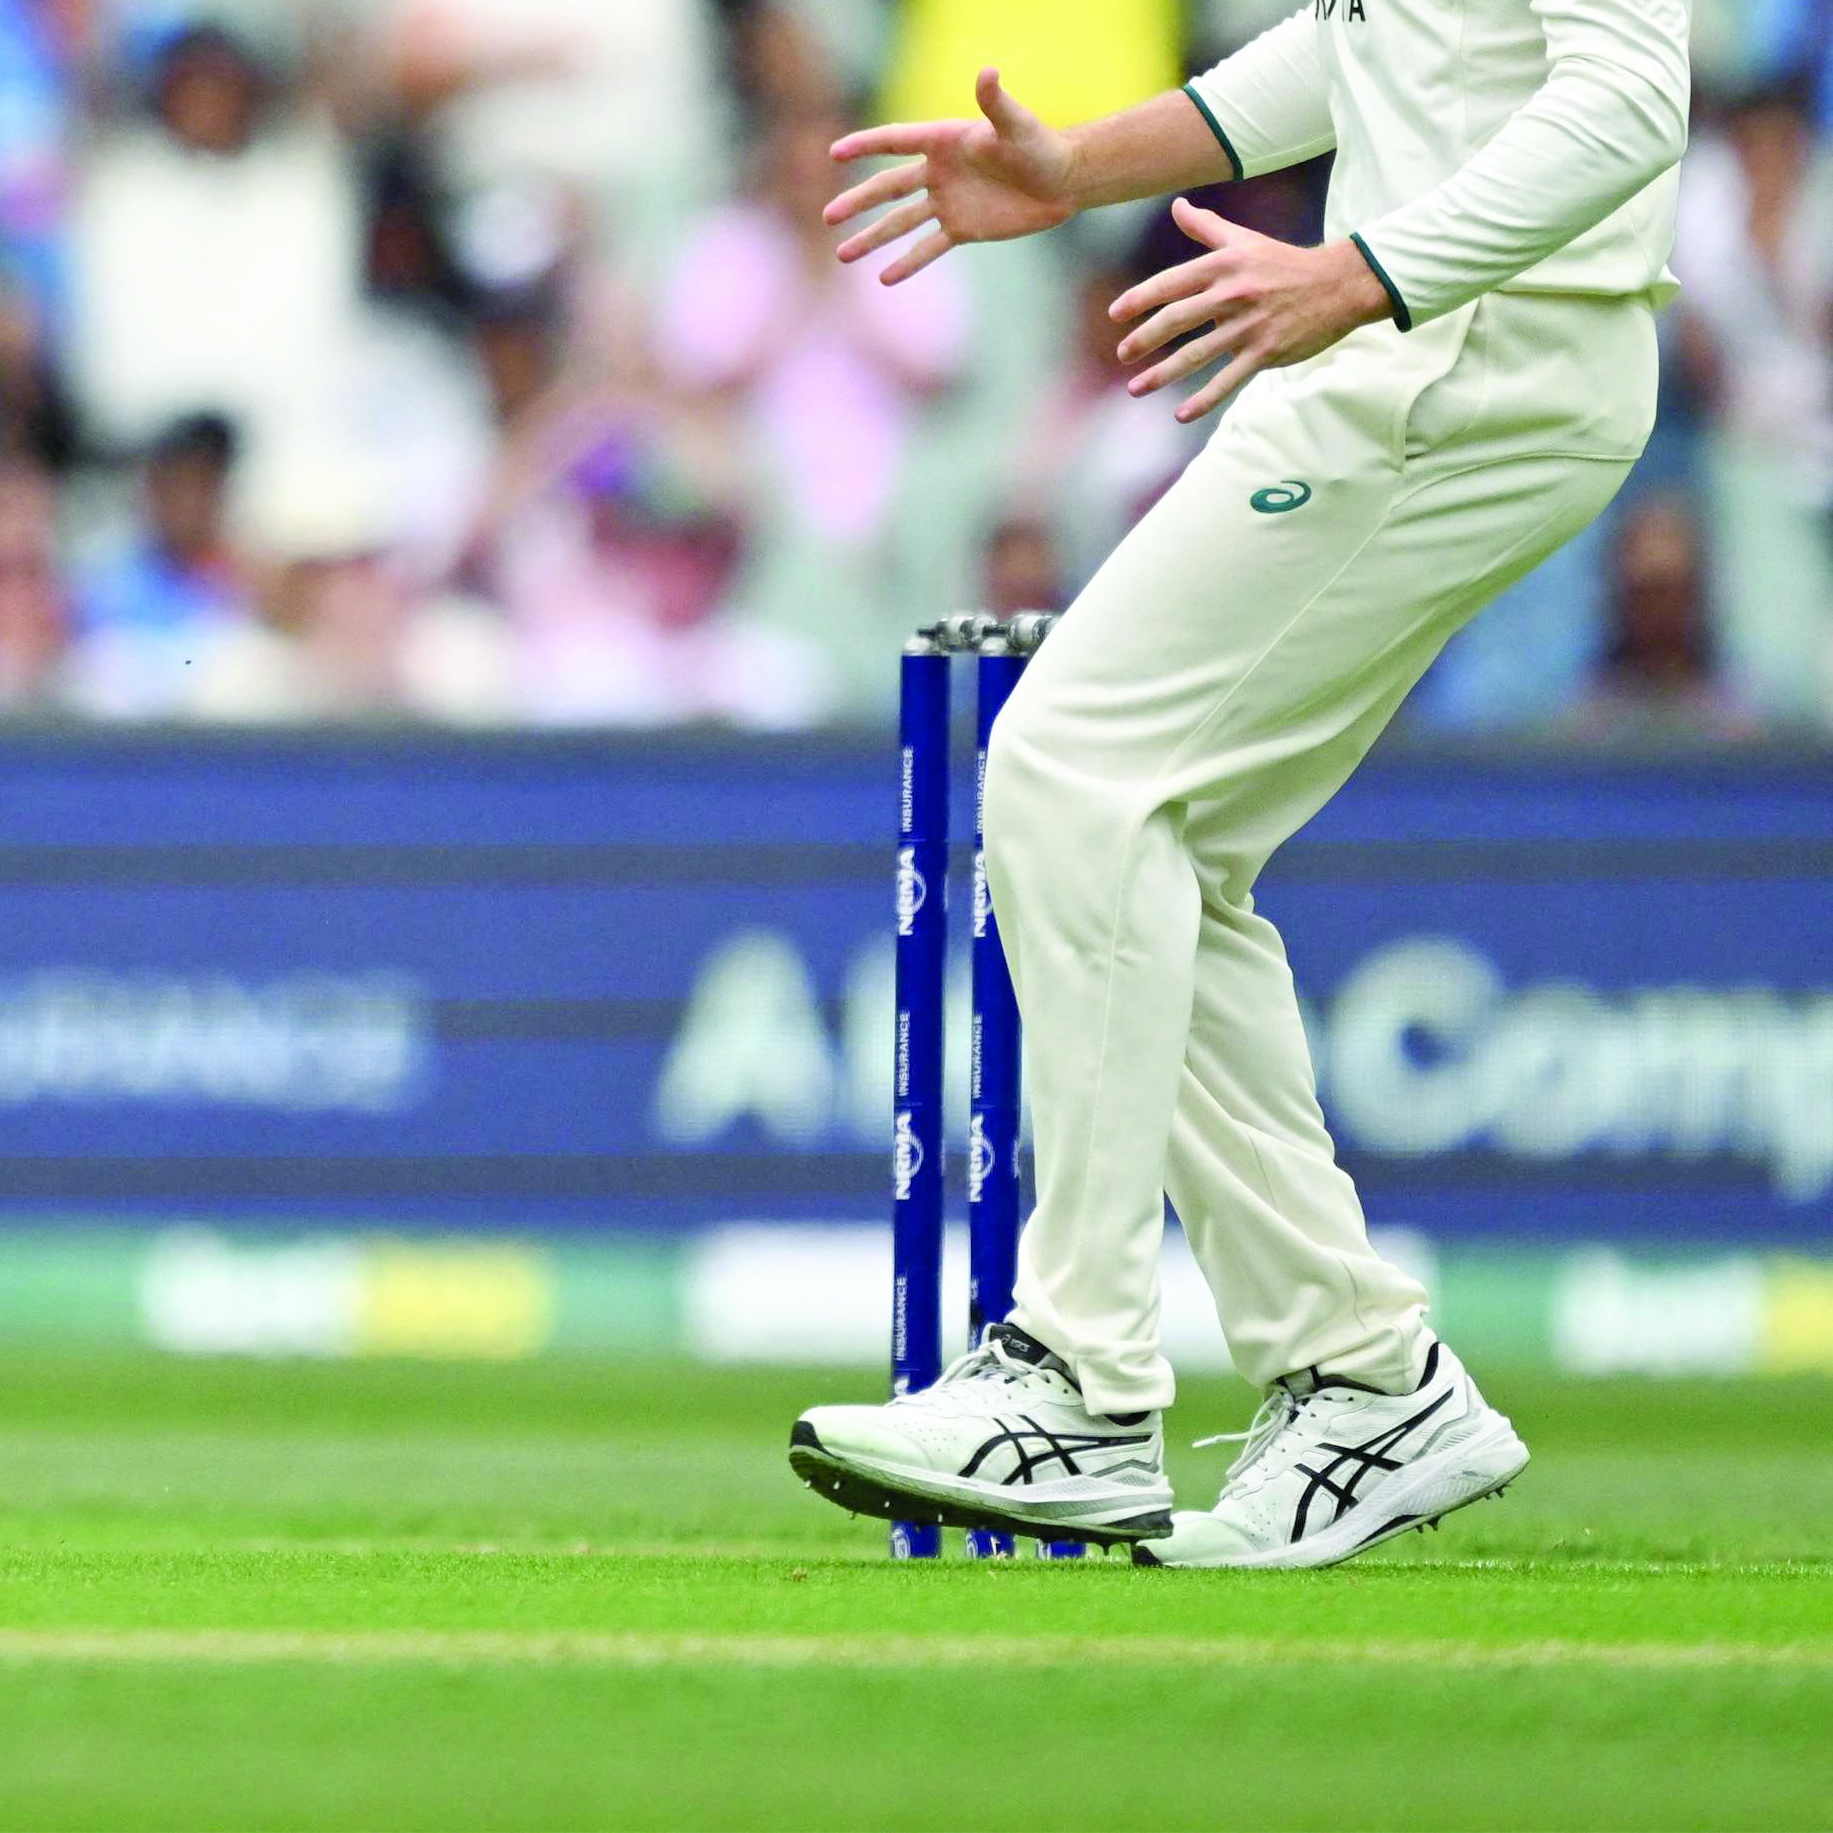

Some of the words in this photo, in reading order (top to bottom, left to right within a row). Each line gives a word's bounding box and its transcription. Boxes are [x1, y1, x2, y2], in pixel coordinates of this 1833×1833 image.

[902, 746, 914, 833] INSURANCE
[898, 845, 916, 936] NRMA
[897, 1009, 910, 1097] INSURANCE
[972, 1013, 983, 1098] INSURANCE
[894, 1109, 912, 1200] NRMA
[970, 1113, 983, 1203] NRMA
[894, 1274, 908, 1362] INSURANCE
